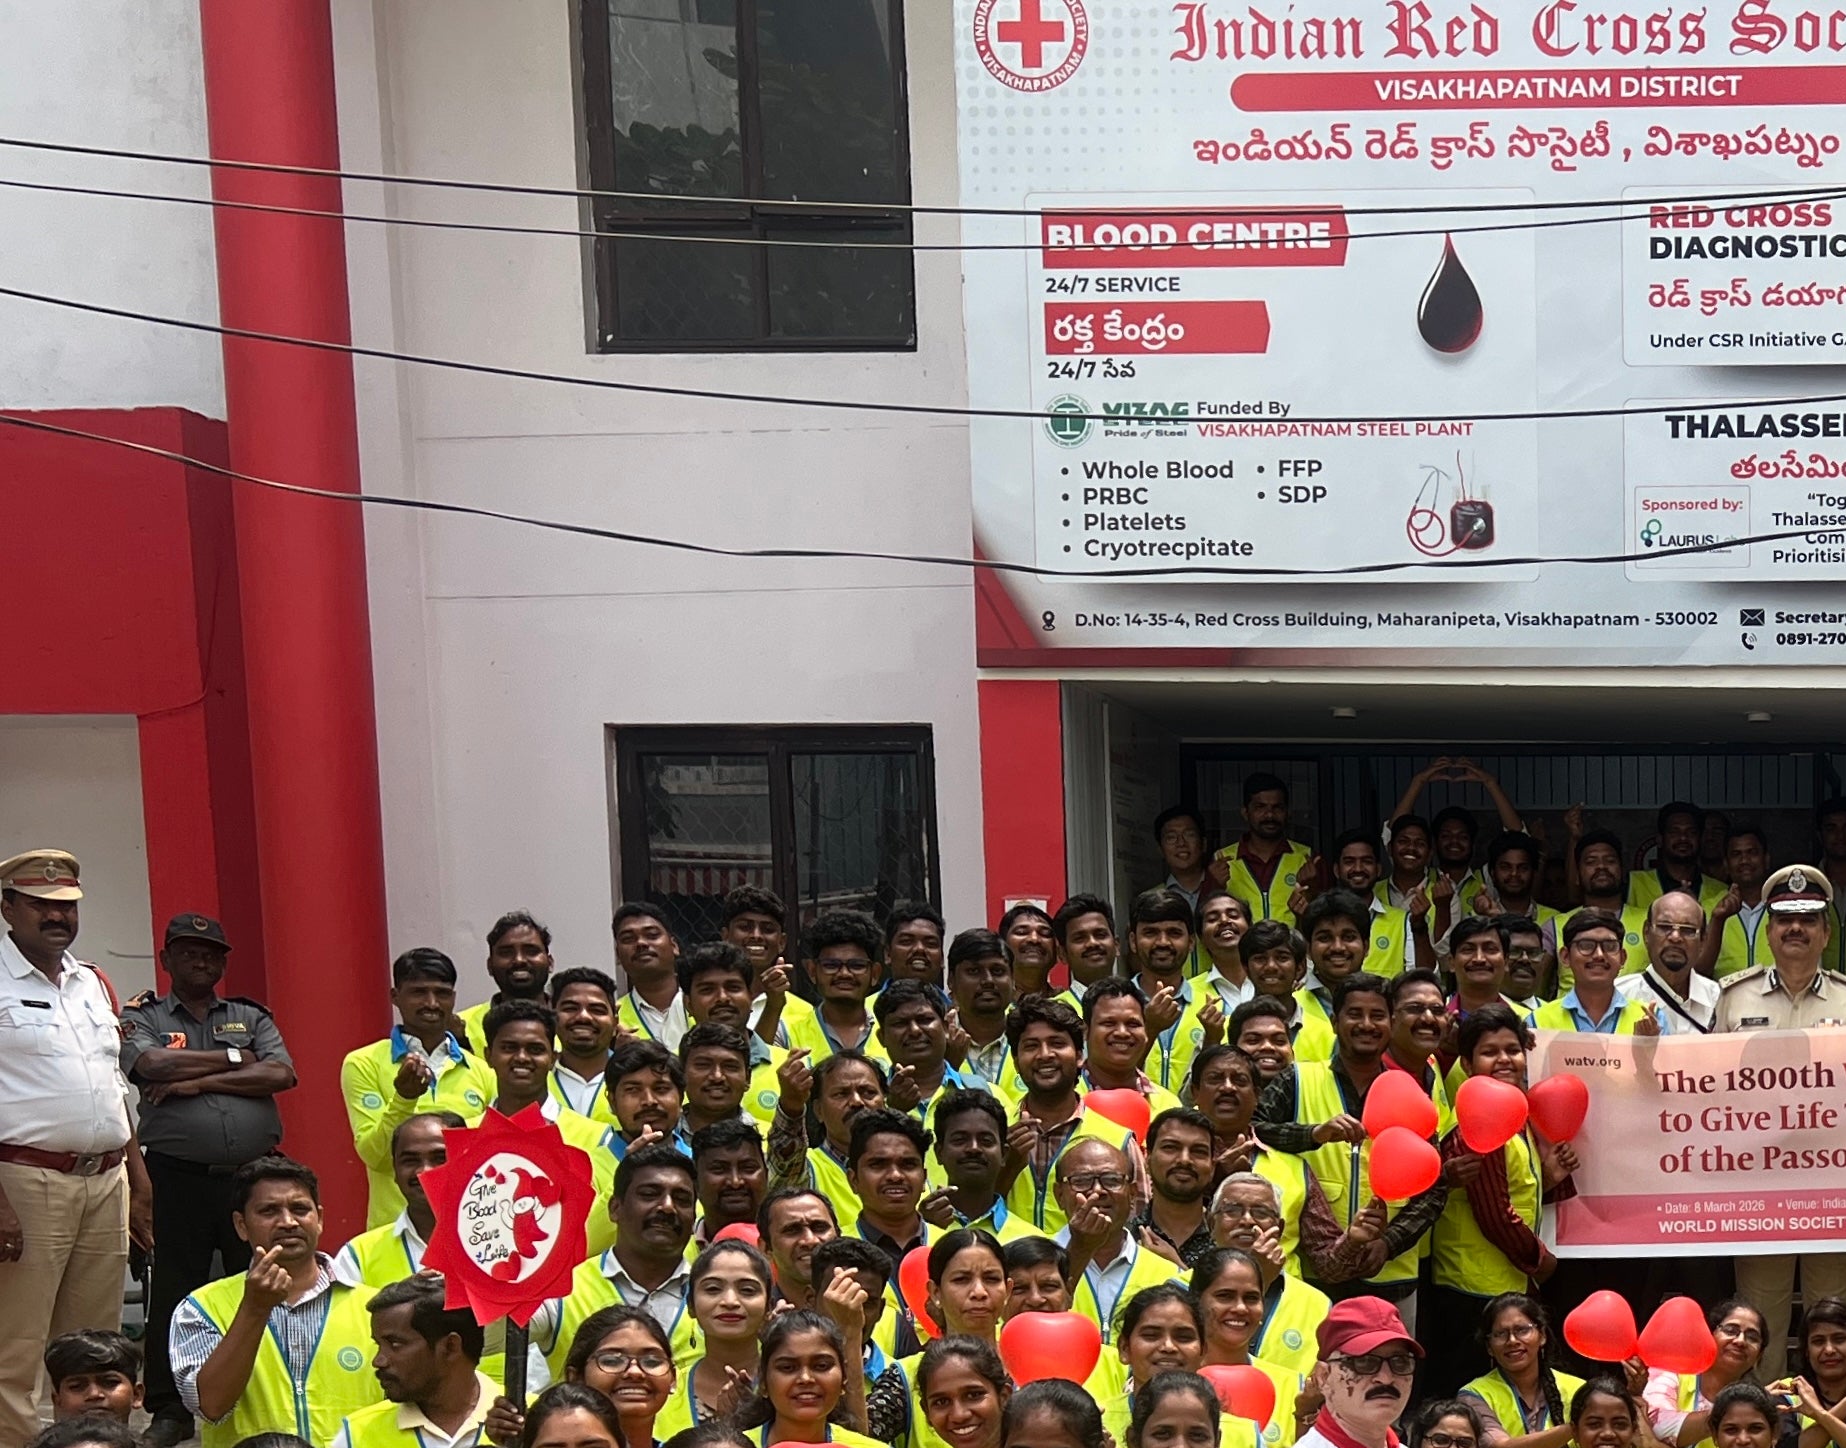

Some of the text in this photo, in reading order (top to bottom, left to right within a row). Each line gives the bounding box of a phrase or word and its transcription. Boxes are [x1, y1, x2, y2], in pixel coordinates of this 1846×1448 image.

[976, 0, 996, 41] INDIA
[1170, 2, 1365, 62] Indian
[1384, 0, 1500, 60] Red
[1533, 0, 1706, 56] Cross
[981, 51, 1082, 91] VISAKHAPATNAM
[1374, 75, 1742, 101] VISAKHAPATNAM DISTRICT
[1193, 123, 1353, 164] ఇండియన్
[1364, 121, 1419, 160] రెడ్
[1431, 121, 1495, 170] క్రాస్
[1643, 124, 1840, 168] విశాఖపట్నం
[1650, 203, 1833, 228] RED CROSS
[1048, 221, 1331, 251] BLOOD CENTRE
[1045, 275, 1181, 294] 24/7 SERVICE
[1649, 279, 1691, 309] రెడ్
[1700, 278, 1752, 316] క్రాస్
[1053, 309, 1185, 354] రక్త కేంద్రం
[1650, 333, 1704, 349] Under
[1709, 334, 1744, 348] CSR
[1750, 332, 1827, 347] Initiative
[1047, 358, 1136, 380] 24/7 సేవ
[1102, 402, 1189, 415] VIZAG
[1197, 401, 1291, 417] Funded By
[1104, 429, 1187, 439] Pride of Steel
[1197, 422, 1473, 437] VISAKHAPATNAM STEEL PLANT
[1082, 460, 1234, 480] Whole Blood
[1278, 460, 1323, 477] FFP
[1083, 488, 1149, 505] PRBC
[1278, 486, 1327, 503] SDP
[1642, 498, 1743, 512] Sponsored by:
[1083, 512, 1186, 532] Platelets
[1083, 538, 1254, 560] Cryotrecpitate
[1659, 535, 1714, 547] LAURUS
[1075, 613, 1121, 627] D.No:
[1125, 613, 1190, 629] 14-35-4,
[1195, 612, 1228, 626] Red
[1232, 613, 1279, 626] Cross
[1285, 611, 1372, 629] Builduing,
[1377, 612, 1501, 629] Maharanipeta,
[1505, 612, 1640, 628] Visakhapatnam
[1655, 612, 1718, 626] 530002
[1564, 1056, 1622, 1070] watv.org
[1656, 1070, 1716, 1095] The
[1726, 1062, 1835, 1091] 1800th
[1659, 1109, 1693, 1133] to
[1700, 1105, 1771, 1132] Give
[1779, 1102, 1838, 1130] Life
[1659, 1146, 1696, 1174] of
[1700, 1145, 1755, 1172] the
[1665, 1203, 1691, 1214] Date:
[1694, 1202, 1700, 1213] 8
[1704, 1201, 1735, 1213] March
[1739, 1200, 1765, 1212] 2026
[1785, 1199, 1819, 1210] Venue:
[469, 1221, 500, 1245] Save
[1658, 1220, 1717, 1233] WORLD
[1721, 1218, 1784, 1231] MISSION
